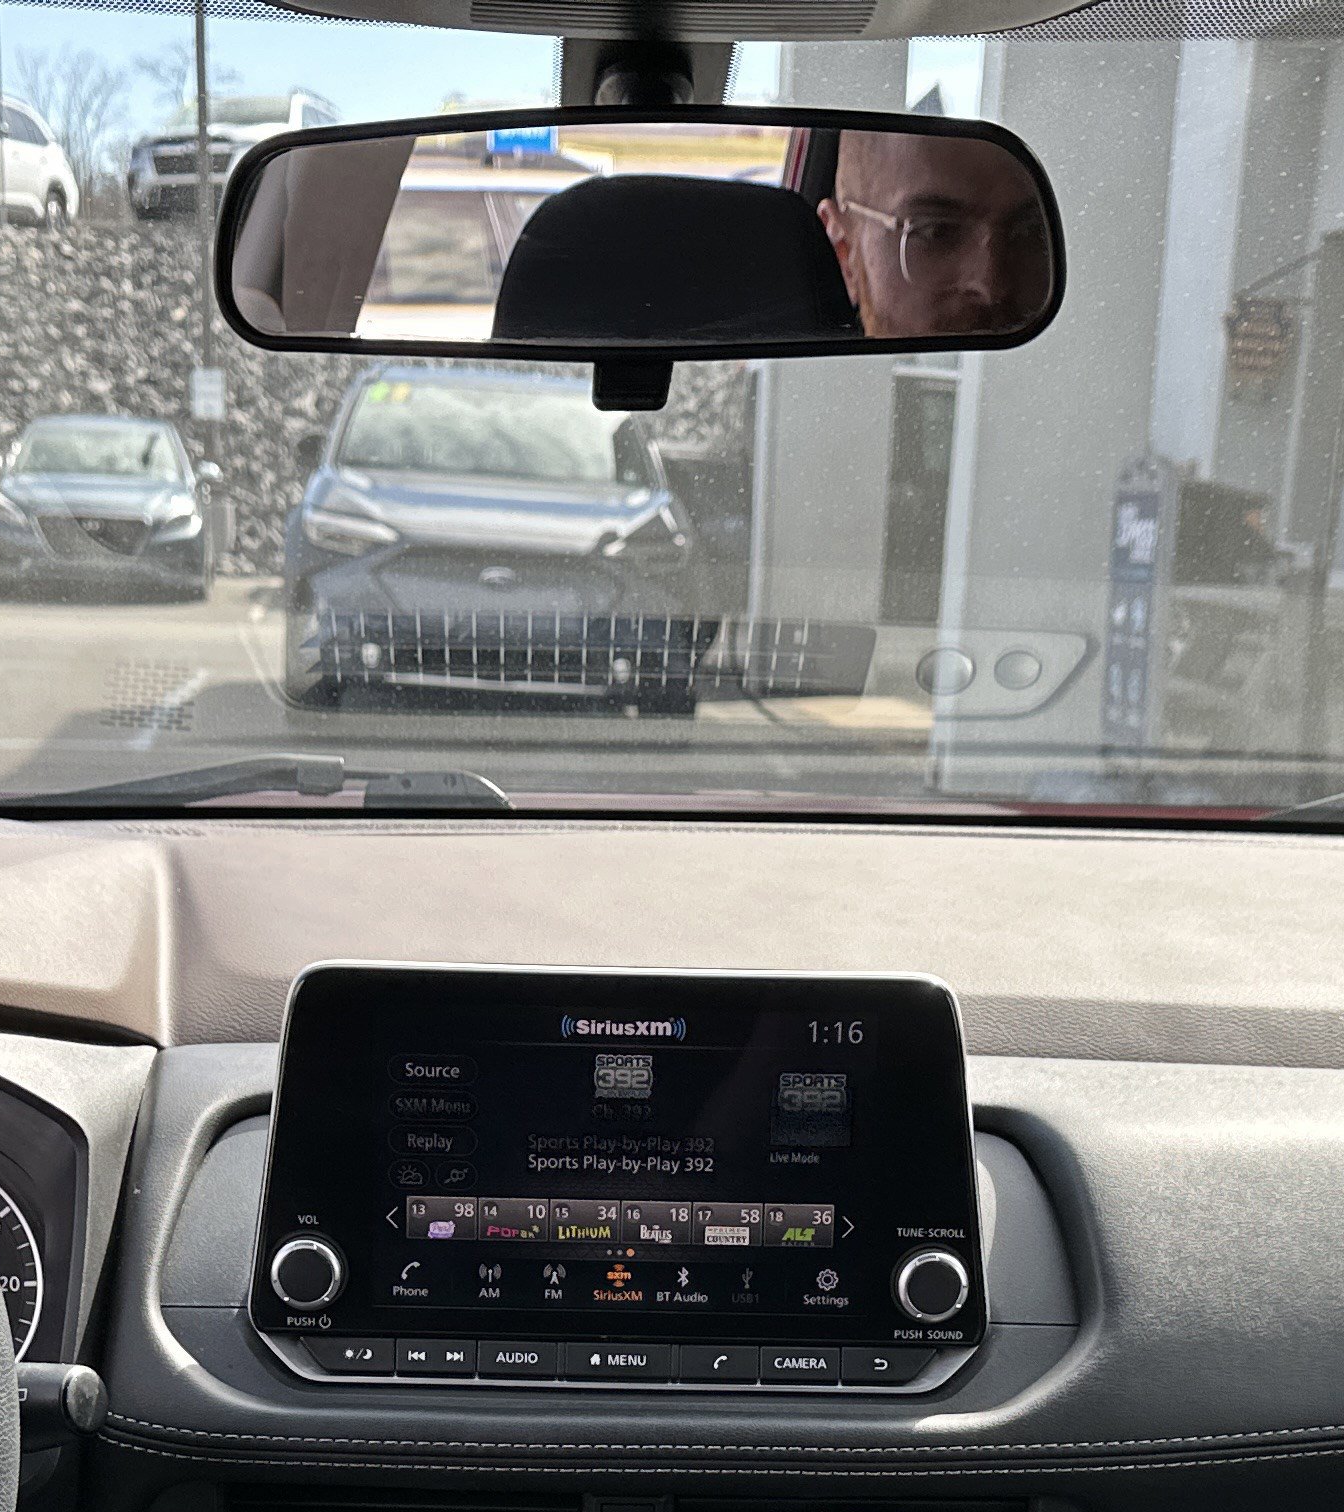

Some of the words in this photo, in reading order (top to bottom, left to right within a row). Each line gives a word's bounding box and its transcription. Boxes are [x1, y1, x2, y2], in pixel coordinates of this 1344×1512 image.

[809, 1020, 864, 1044] 1:16
[596, 1056, 652, 1067] SPORTS
[405, 1063, 460, 1079] Source
[597, 1069, 649, 1089] 392
[781, 1074, 846, 1088] SPORTS
[407, 1133, 453, 1151] Replay
[528, 1134, 578, 1154] Sports
[684, 1138, 714, 1152] 392
[528, 1154, 578, 1173] Sports
[583, 1155, 679, 1175] Play-by-Play
[684, 1158, 714, 1172] 392
[412, 1204, 425, 1215] 13
[455, 1203, 475, 1218] 98
[484, 1206, 498, 1217] 14
[528, 1205, 546, 1220] 10
[556, 1207, 569, 1219] 15
[598, 1206, 617, 1221] 34
[627, 1209, 641, 1220] 16
[670, 1208, 689, 1222] 18
[698, 1211, 712, 1221] 17
[741, 1209, 760, 1223] 58
[297, 1215, 319, 1225] VOL
[770, 1212, 784, 1222] 18
[812, 1211, 832, 1225] 36
[558, 1226, 611, 1240] LITHIUM
[706, 1236, 748, 1244] COUNTRY
[782, 1228, 816, 1241] ALT
[0, 1275, 21, 1293] 20
[392, 1286, 429, 1297] Phone
[479, 1288, 501, 1298] AM
[544, 1289, 563, 1299] FM
[593, 1290, 643, 1302] SiriusXM
[656, 1291, 670, 1303] BT
[674, 1291, 708, 1303] Audio
[803, 1294, 849, 1308] Settings
[286, 1316, 316, 1327] PUSH
[894, 1330, 923, 1340] PUSH
[927, 1330, 963, 1341] SOUND
[495, 1351, 539, 1364] AUDIO
[607, 1354, 647, 1367] MENU
[774, 1358, 827, 1370] CAMERA
